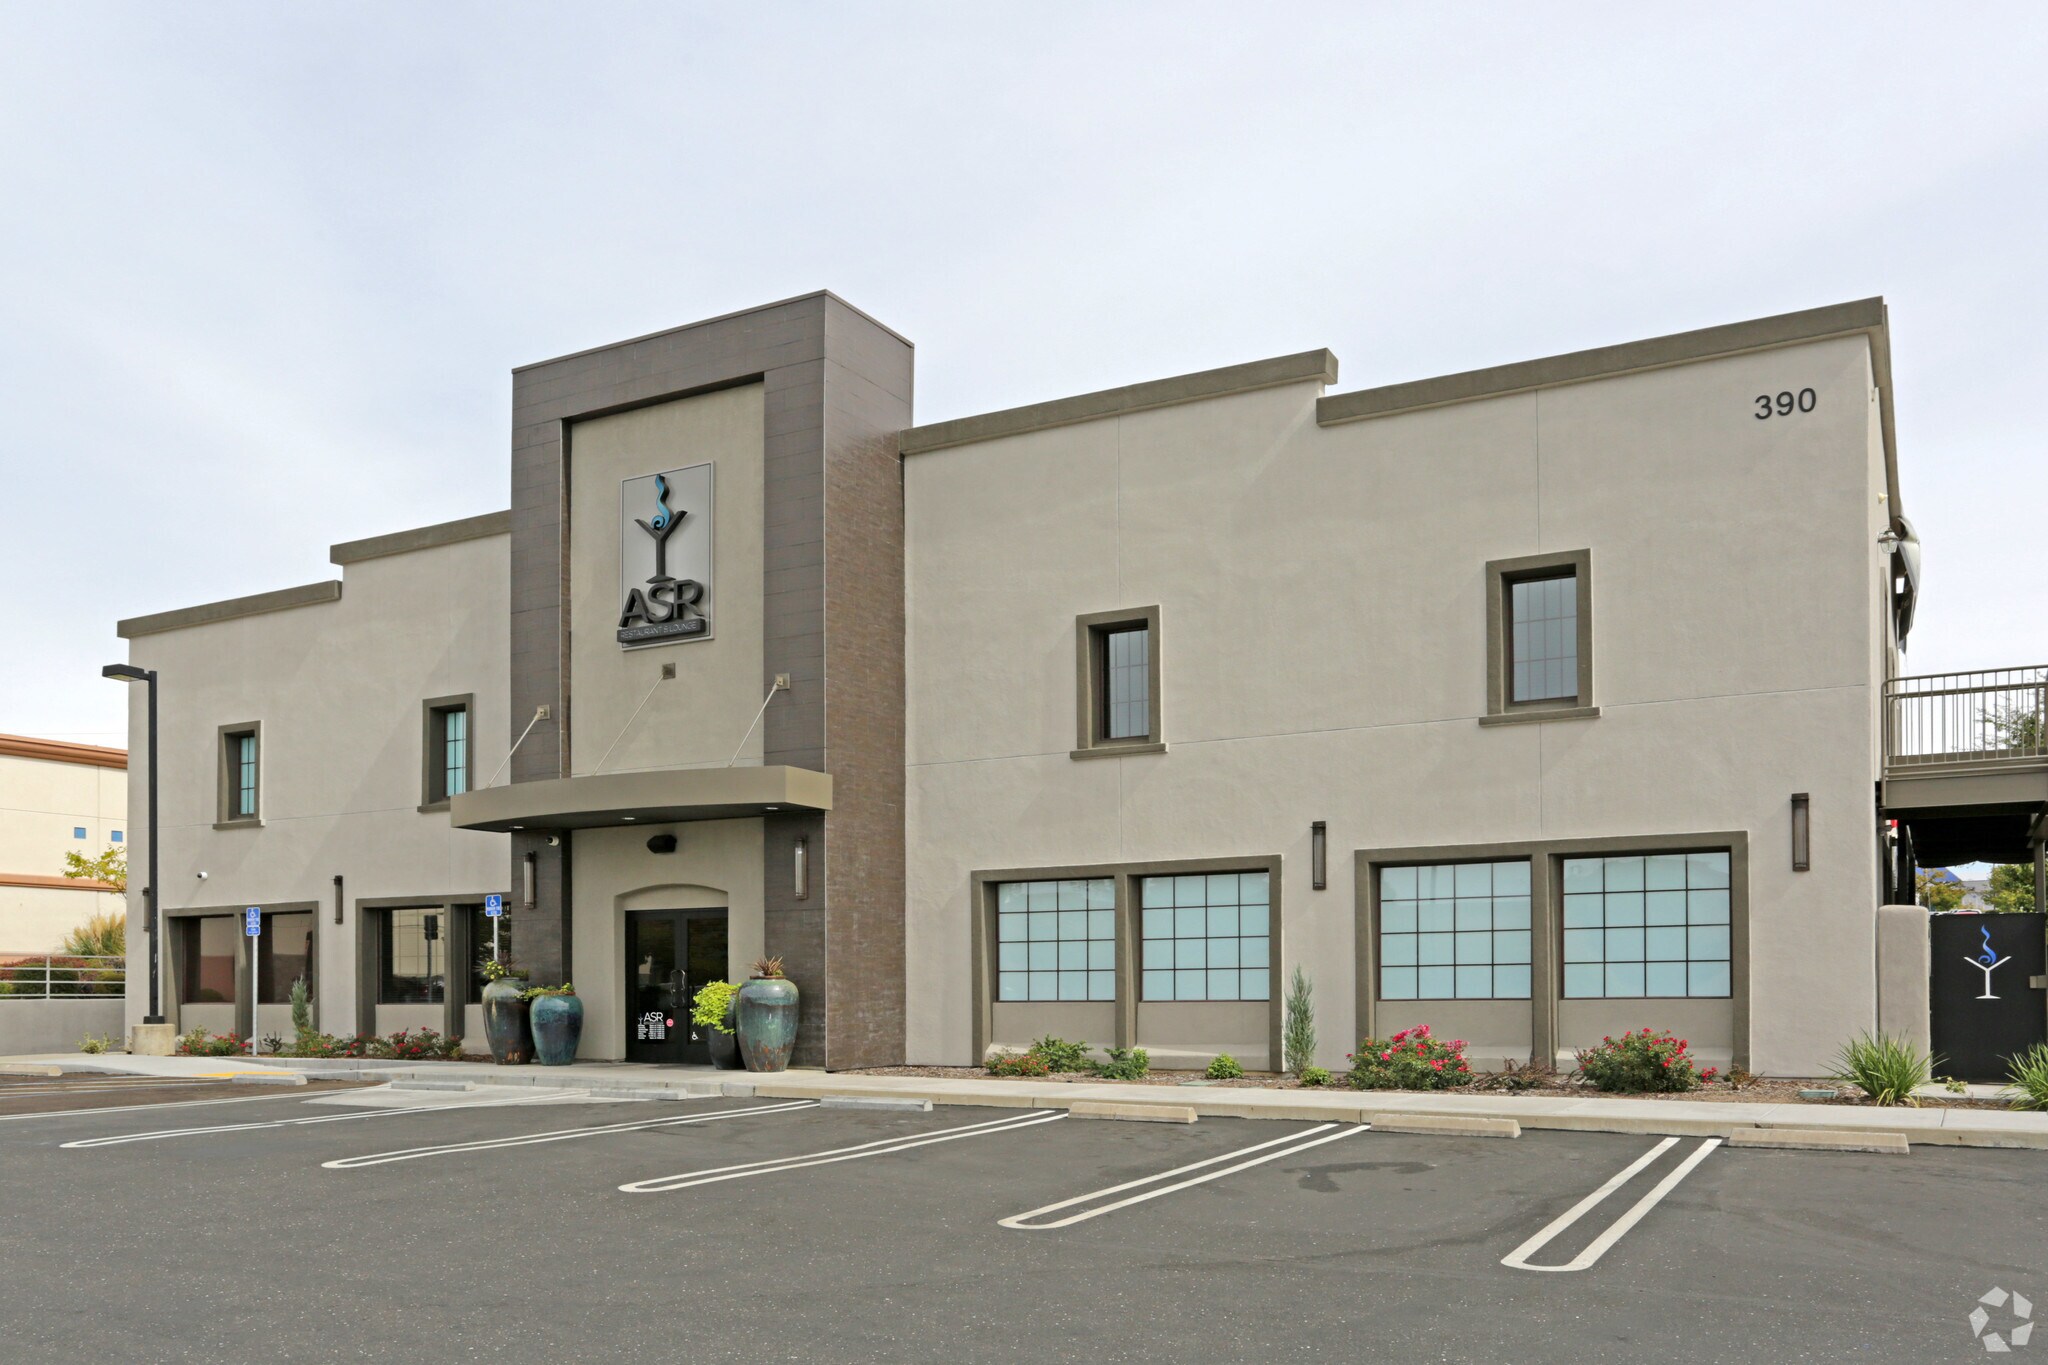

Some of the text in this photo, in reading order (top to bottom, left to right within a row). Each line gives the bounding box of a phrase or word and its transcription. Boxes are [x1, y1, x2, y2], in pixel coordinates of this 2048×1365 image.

[1754, 387, 1817, 420] 390
[618, 579, 705, 627] ASR
[620, 626, 662, 639] RESTAURANT
[669, 621, 697, 633] LOUNGE
[643, 1012, 664, 1022] ASR
